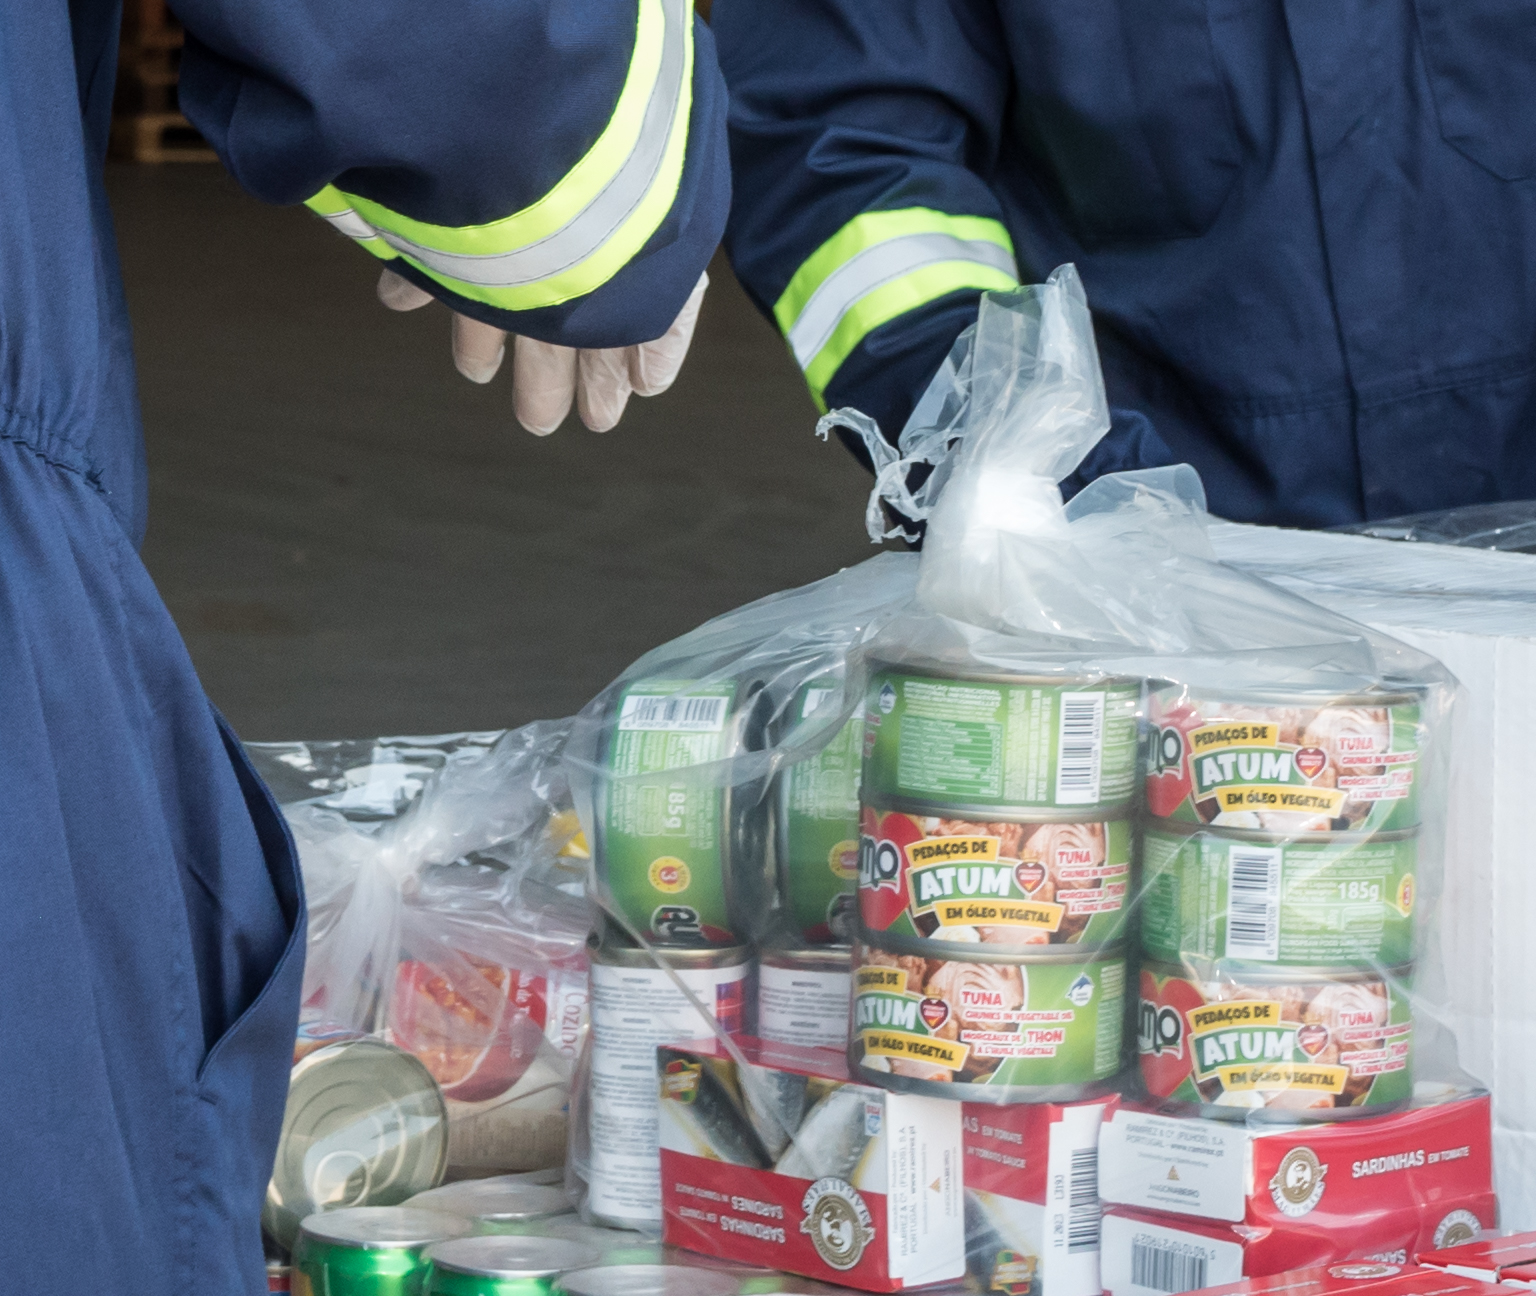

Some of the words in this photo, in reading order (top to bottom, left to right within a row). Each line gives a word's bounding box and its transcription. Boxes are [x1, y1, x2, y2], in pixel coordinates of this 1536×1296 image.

[1194, 728, 1249, 746] PEDAÇOS
[1252, 726, 1268, 739] DE
[1339, 737, 1374, 751] TUNA
[1202, 753, 1292, 786] ATUM
[1227, 793, 1243, 805] EM
[1246, 790, 1276, 804] ÓLEO
[1280, 793, 1333, 809] VEGETAL
[912, 841, 968, 861] PEDAÇOS
[972, 840, 988, 854] DE
[1058, 850, 1091, 864] TUNA
[920, 866, 1013, 901] ATUM
[1337, 881, 1380, 903] 185g
[946, 907, 963, 919] EM
[966, 904, 997, 919] ÓLEO
[1001, 907, 1050, 923] VEGETAL
[962, 991, 1002, 1005] TUNA
[858, 996, 916, 1030] ATUM
[1194, 1008, 1251, 1025] PEDAÇOS
[1254, 1005, 1271, 1019] DE
[1340, 1013, 1374, 1026] TUNA
[1027, 1030, 1063, 1042] THON
[880, 1034, 903, 1051] ÓLEO
[906, 1041, 955, 1062] VEGETAL
[1204, 1031, 1296, 1066] ATUM
[1351, 1149, 1425, 1178] SARDINHAS
[730, 1195, 784, 1219] SARDINES
[719, 1215, 786, 1243] SARDINHAS
[909, 1203, 918, 1253] PORTUGAL
